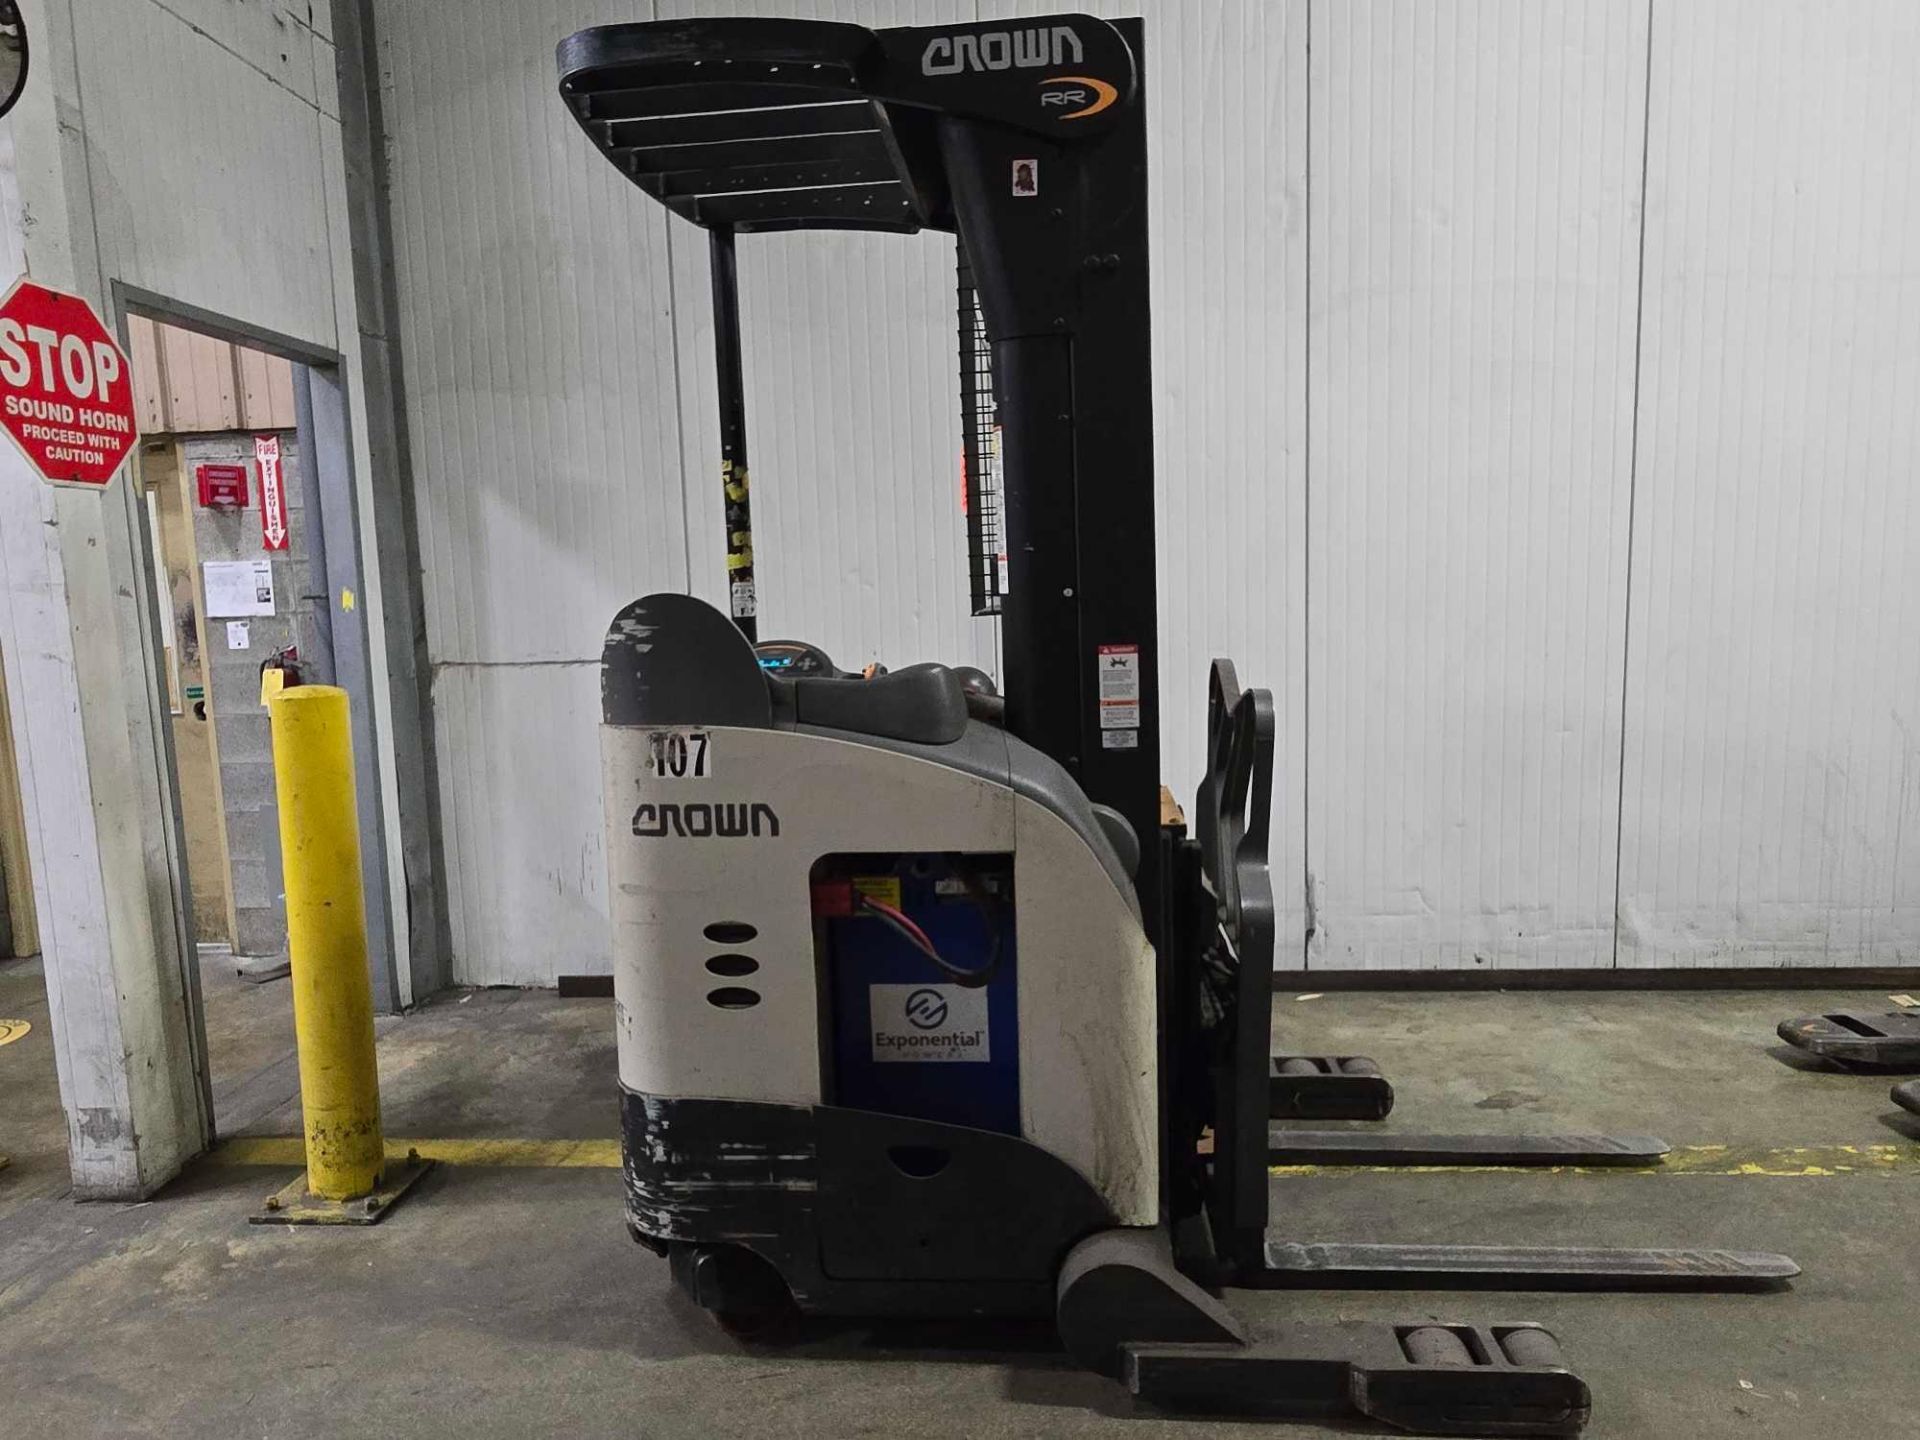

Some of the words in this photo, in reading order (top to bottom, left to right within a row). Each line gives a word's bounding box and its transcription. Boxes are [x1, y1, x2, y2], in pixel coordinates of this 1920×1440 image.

[921, 26, 1083, 76] CROWN
[1041, 90, 1086, 107] RR
[0, 317, 119, 403] STOP
[6, 394, 74, 424] SOUND
[79, 407, 129, 433] HORN
[22, 423, 85, 445] PROCEED
[88, 433, 120, 450] WITH
[258, 444, 276, 455] FIRE
[45, 446, 104, 465] CAUTION
[265, 459, 280, 541] EXTINGUISHER
[652, 732, 710, 777] 107
[632, 803, 779, 837] CROWN
